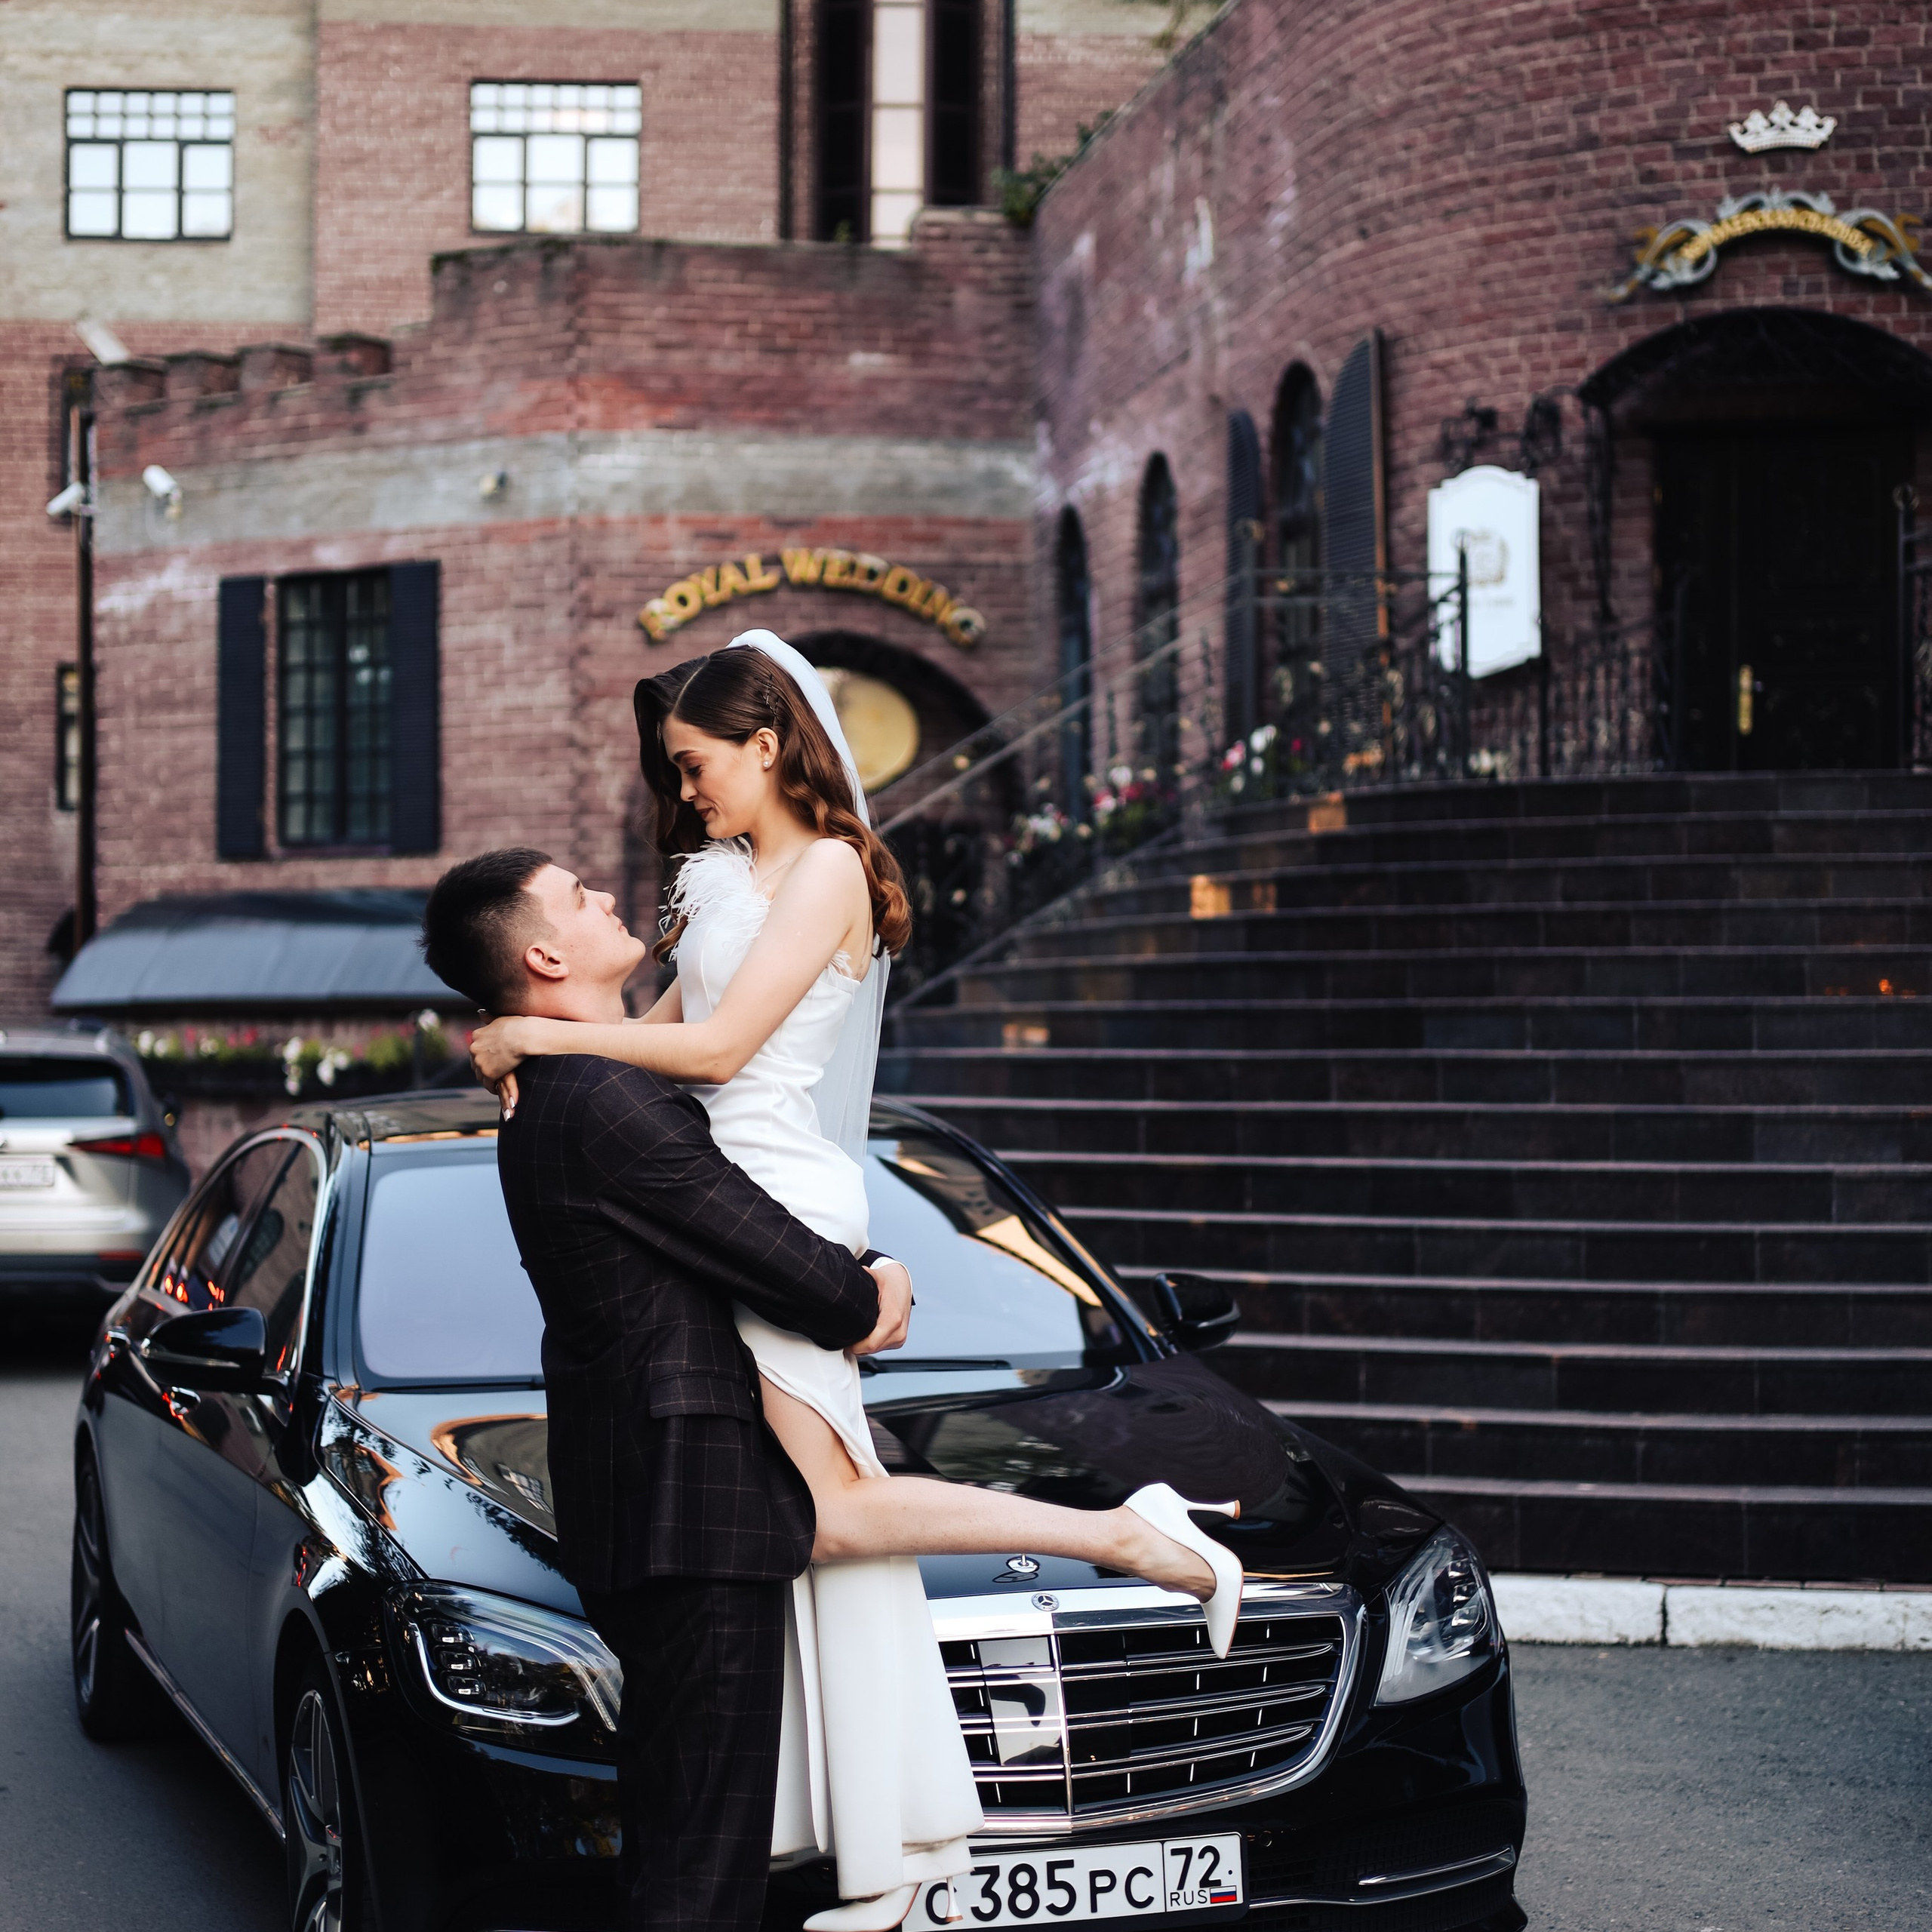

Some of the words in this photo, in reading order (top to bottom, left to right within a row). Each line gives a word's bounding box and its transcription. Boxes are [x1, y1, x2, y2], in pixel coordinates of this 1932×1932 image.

[638, 552, 780, 641] ROYAL
[780, 547, 985, 645] WEDDING
[1170, 1844, 1222, 1890] 72
[1169, 1889, 1208, 1907] RUS
